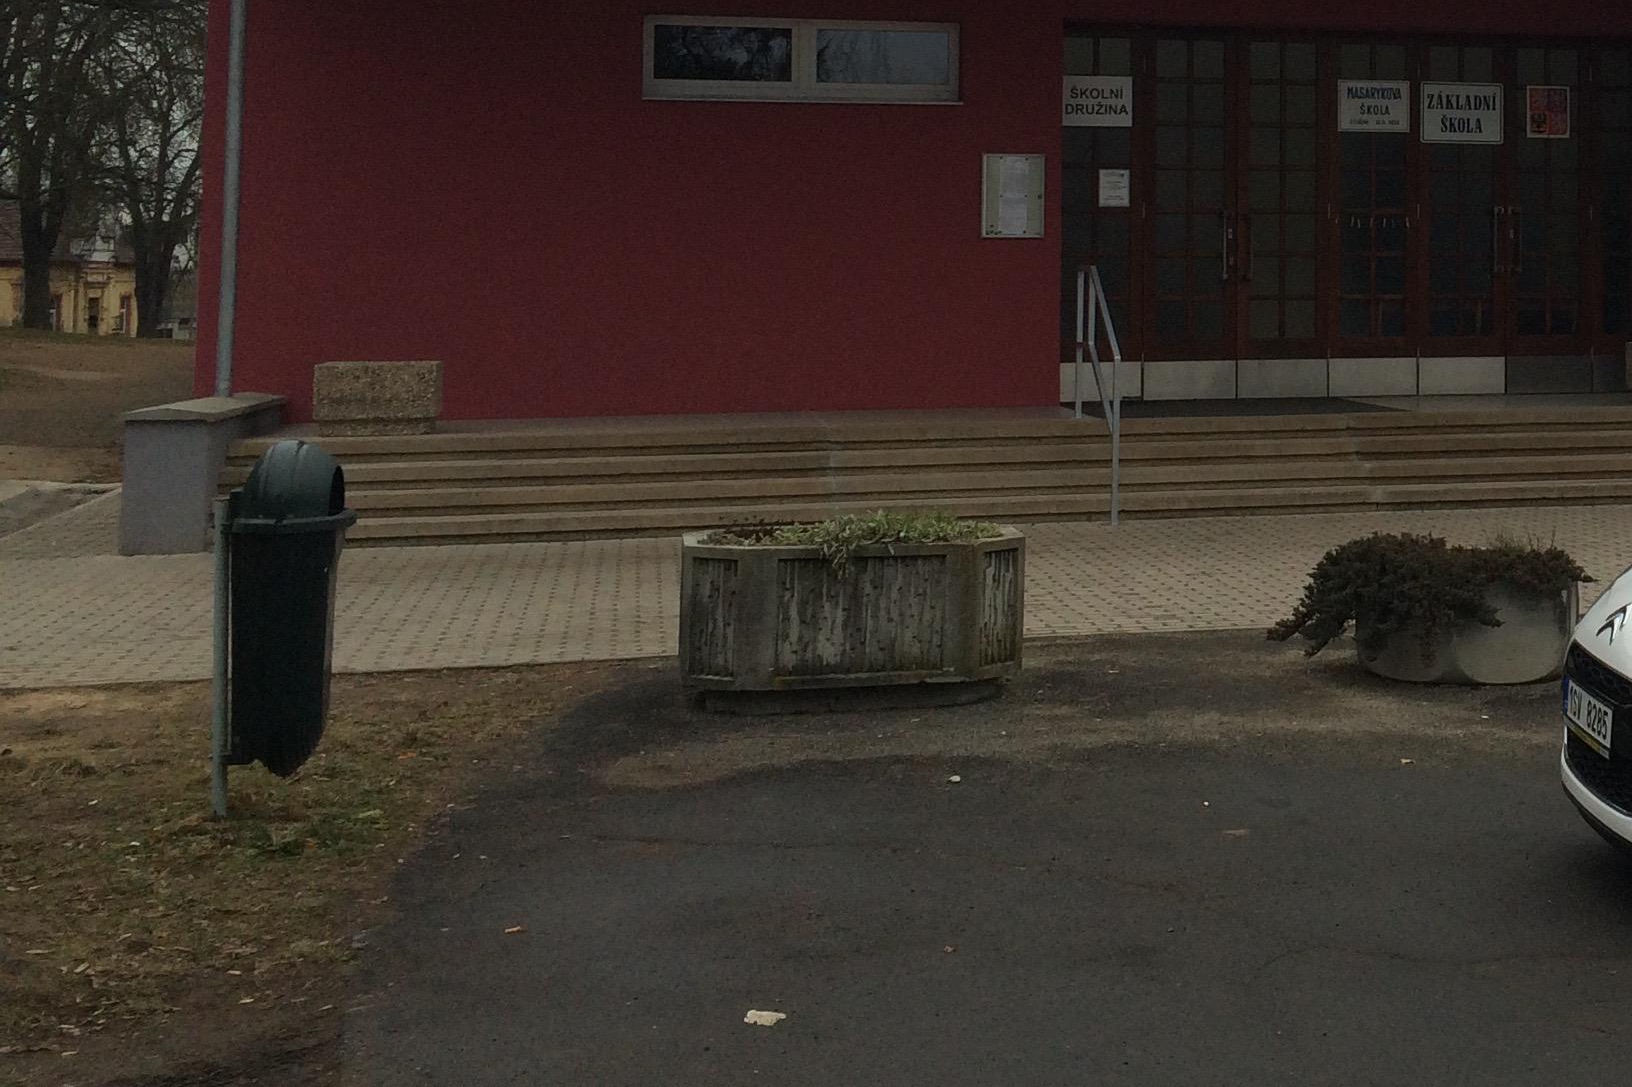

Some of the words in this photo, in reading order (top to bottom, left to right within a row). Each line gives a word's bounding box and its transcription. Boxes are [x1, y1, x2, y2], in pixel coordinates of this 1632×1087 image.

[1070, 85, 1123, 99] ŠKOLNÍ
[1346, 86, 1402, 100] MASARYKOVA
[1065, 101, 1129, 115] DRUŽINA
[1427, 91, 1497, 111] ZÁKLADNÍ
[1360, 102, 1391, 115] ŠKOLA
[1441, 114, 1483, 133] ŠKOLA
